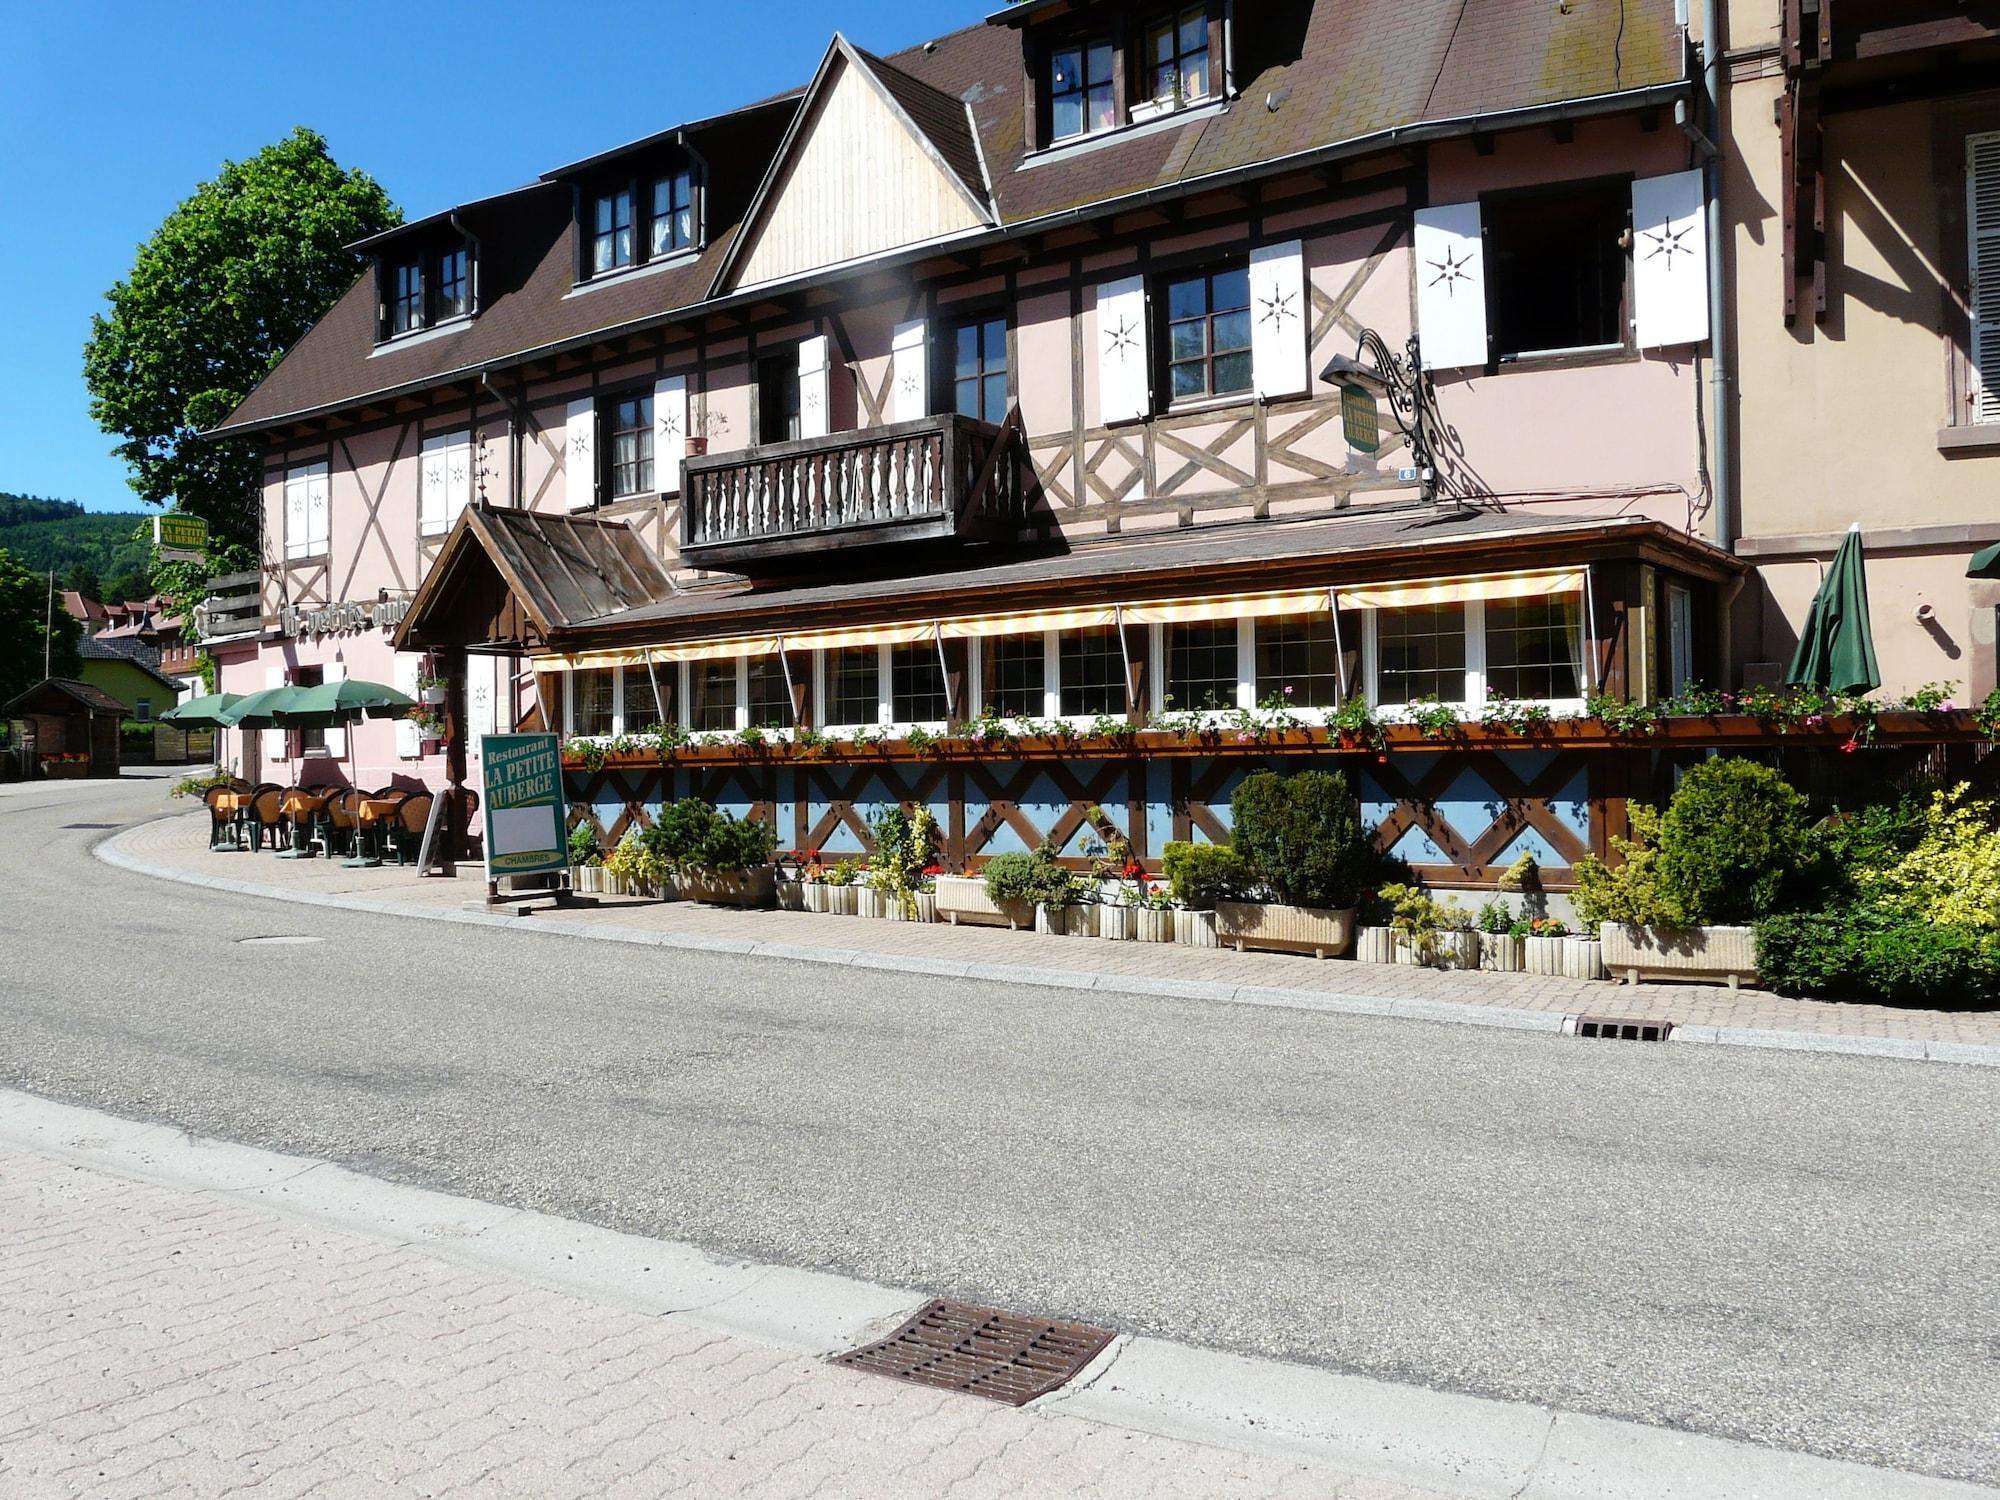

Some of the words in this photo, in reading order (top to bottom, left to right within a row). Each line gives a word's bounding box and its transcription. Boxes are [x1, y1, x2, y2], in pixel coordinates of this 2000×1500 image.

[161, 525, 172, 534] LA
[175, 527, 205, 539] PETITE
[163, 534, 205, 545] AUBERGE
[487, 737, 549, 766] Restaurant
[485, 767, 503, 789] LA
[506, 750, 556, 783] PETITE
[489, 772, 553, 810] AUBERGE
[504, 853, 550, 866] CHAMBRES
